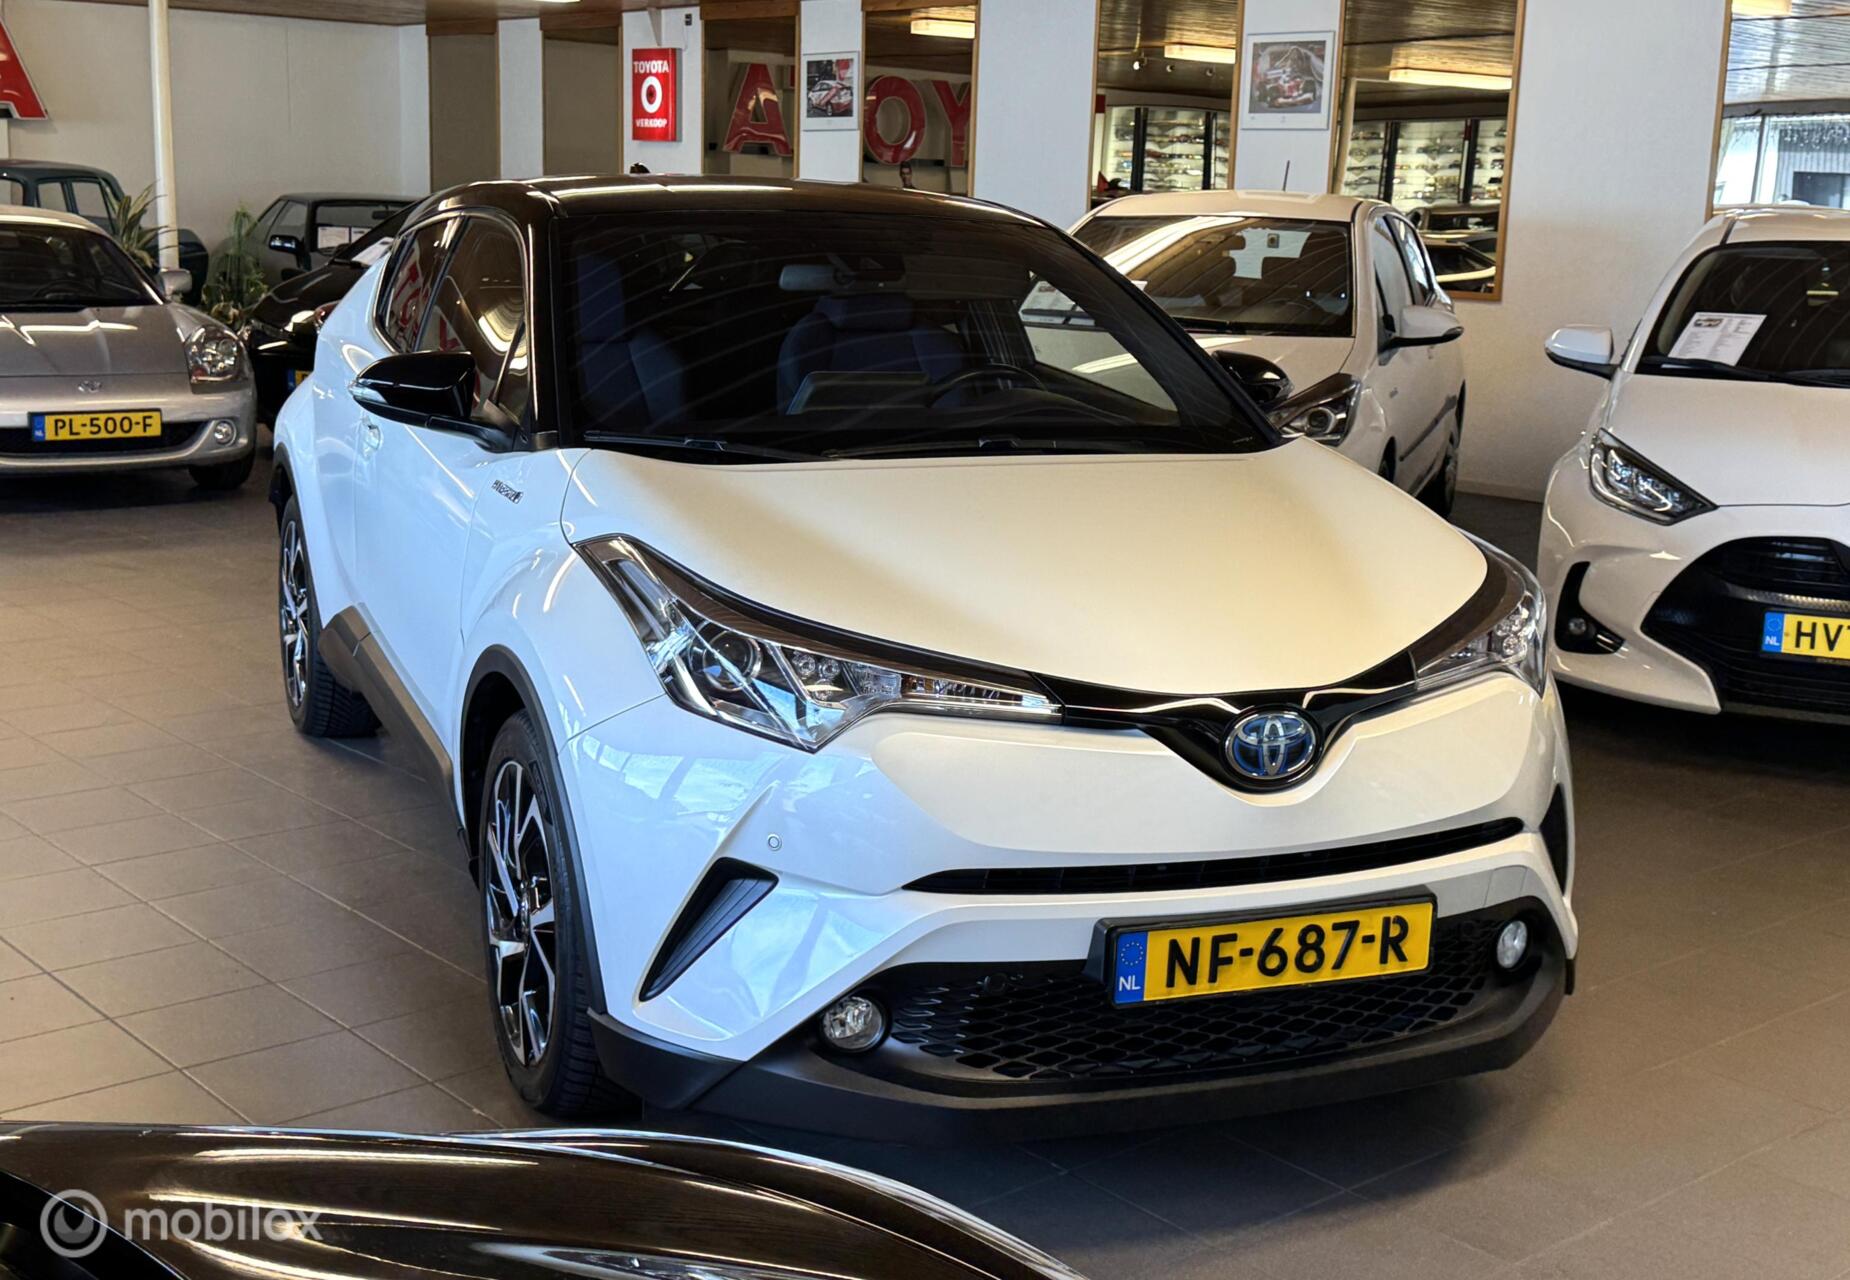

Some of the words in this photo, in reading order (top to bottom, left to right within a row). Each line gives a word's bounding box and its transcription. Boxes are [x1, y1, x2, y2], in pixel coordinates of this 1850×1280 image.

[633, 60, 670, 74] TOYOTA
[54, 415, 153, 436] PL-500-F
[1765, 635, 1780, 646] NL
[1795, 620, 1850, 652] HV
[1119, 975, 1141, 992] NL
[1165, 915, 1409, 988] NF-687-R
